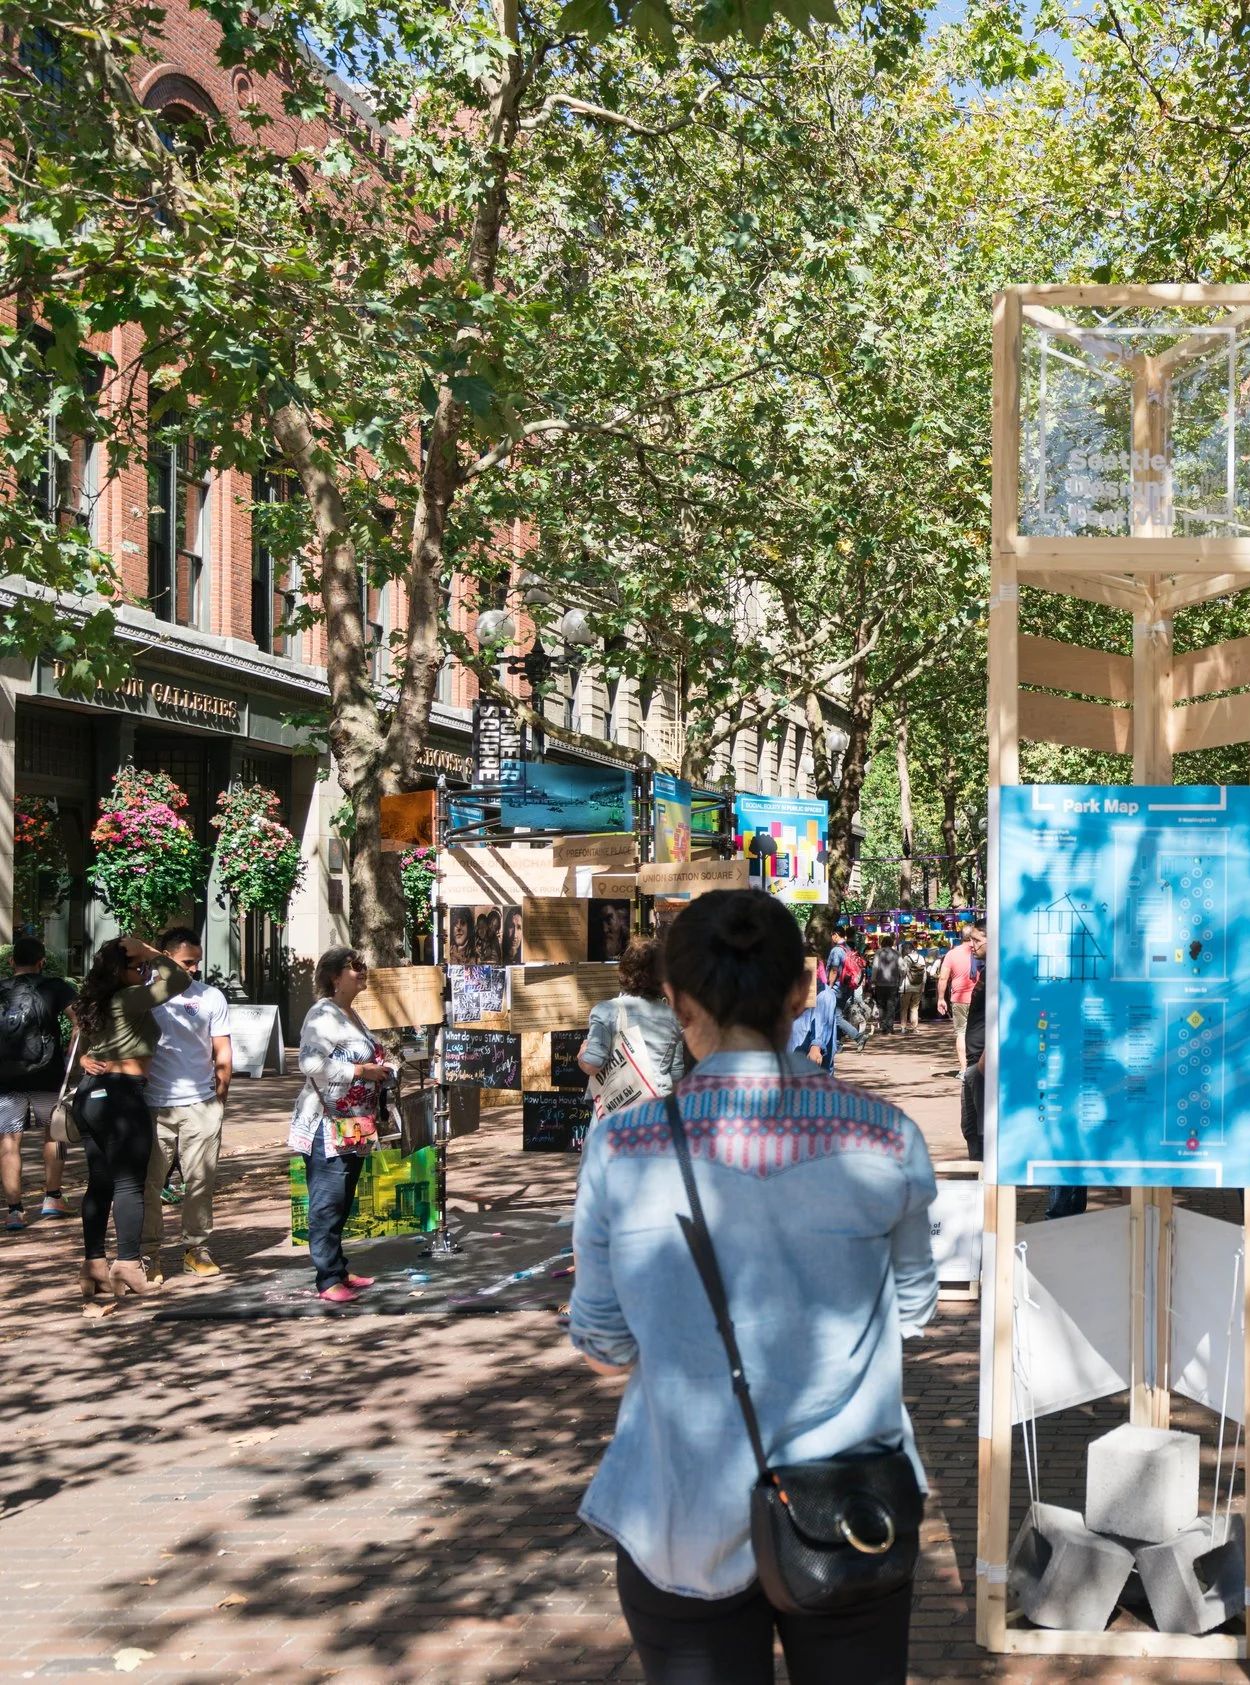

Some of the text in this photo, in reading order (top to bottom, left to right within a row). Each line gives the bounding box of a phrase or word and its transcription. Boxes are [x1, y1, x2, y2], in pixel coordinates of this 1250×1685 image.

[1069, 448, 1167, 472] Seattle
[151, 683, 238, 719] GALLERIES
[479, 706, 500, 781] SQUARE
[1063, 798, 1139, 816] Park Map
[642, 870, 733, 883] UNION STATION SQUARE
[611, 885, 633, 893] OCC
[445, 1031, 517, 1044] What do you STAND for
[524, 1094, 539, 1104] How
[540, 1096, 557, 1108] Long
[558, 1096, 577, 1105] Have
